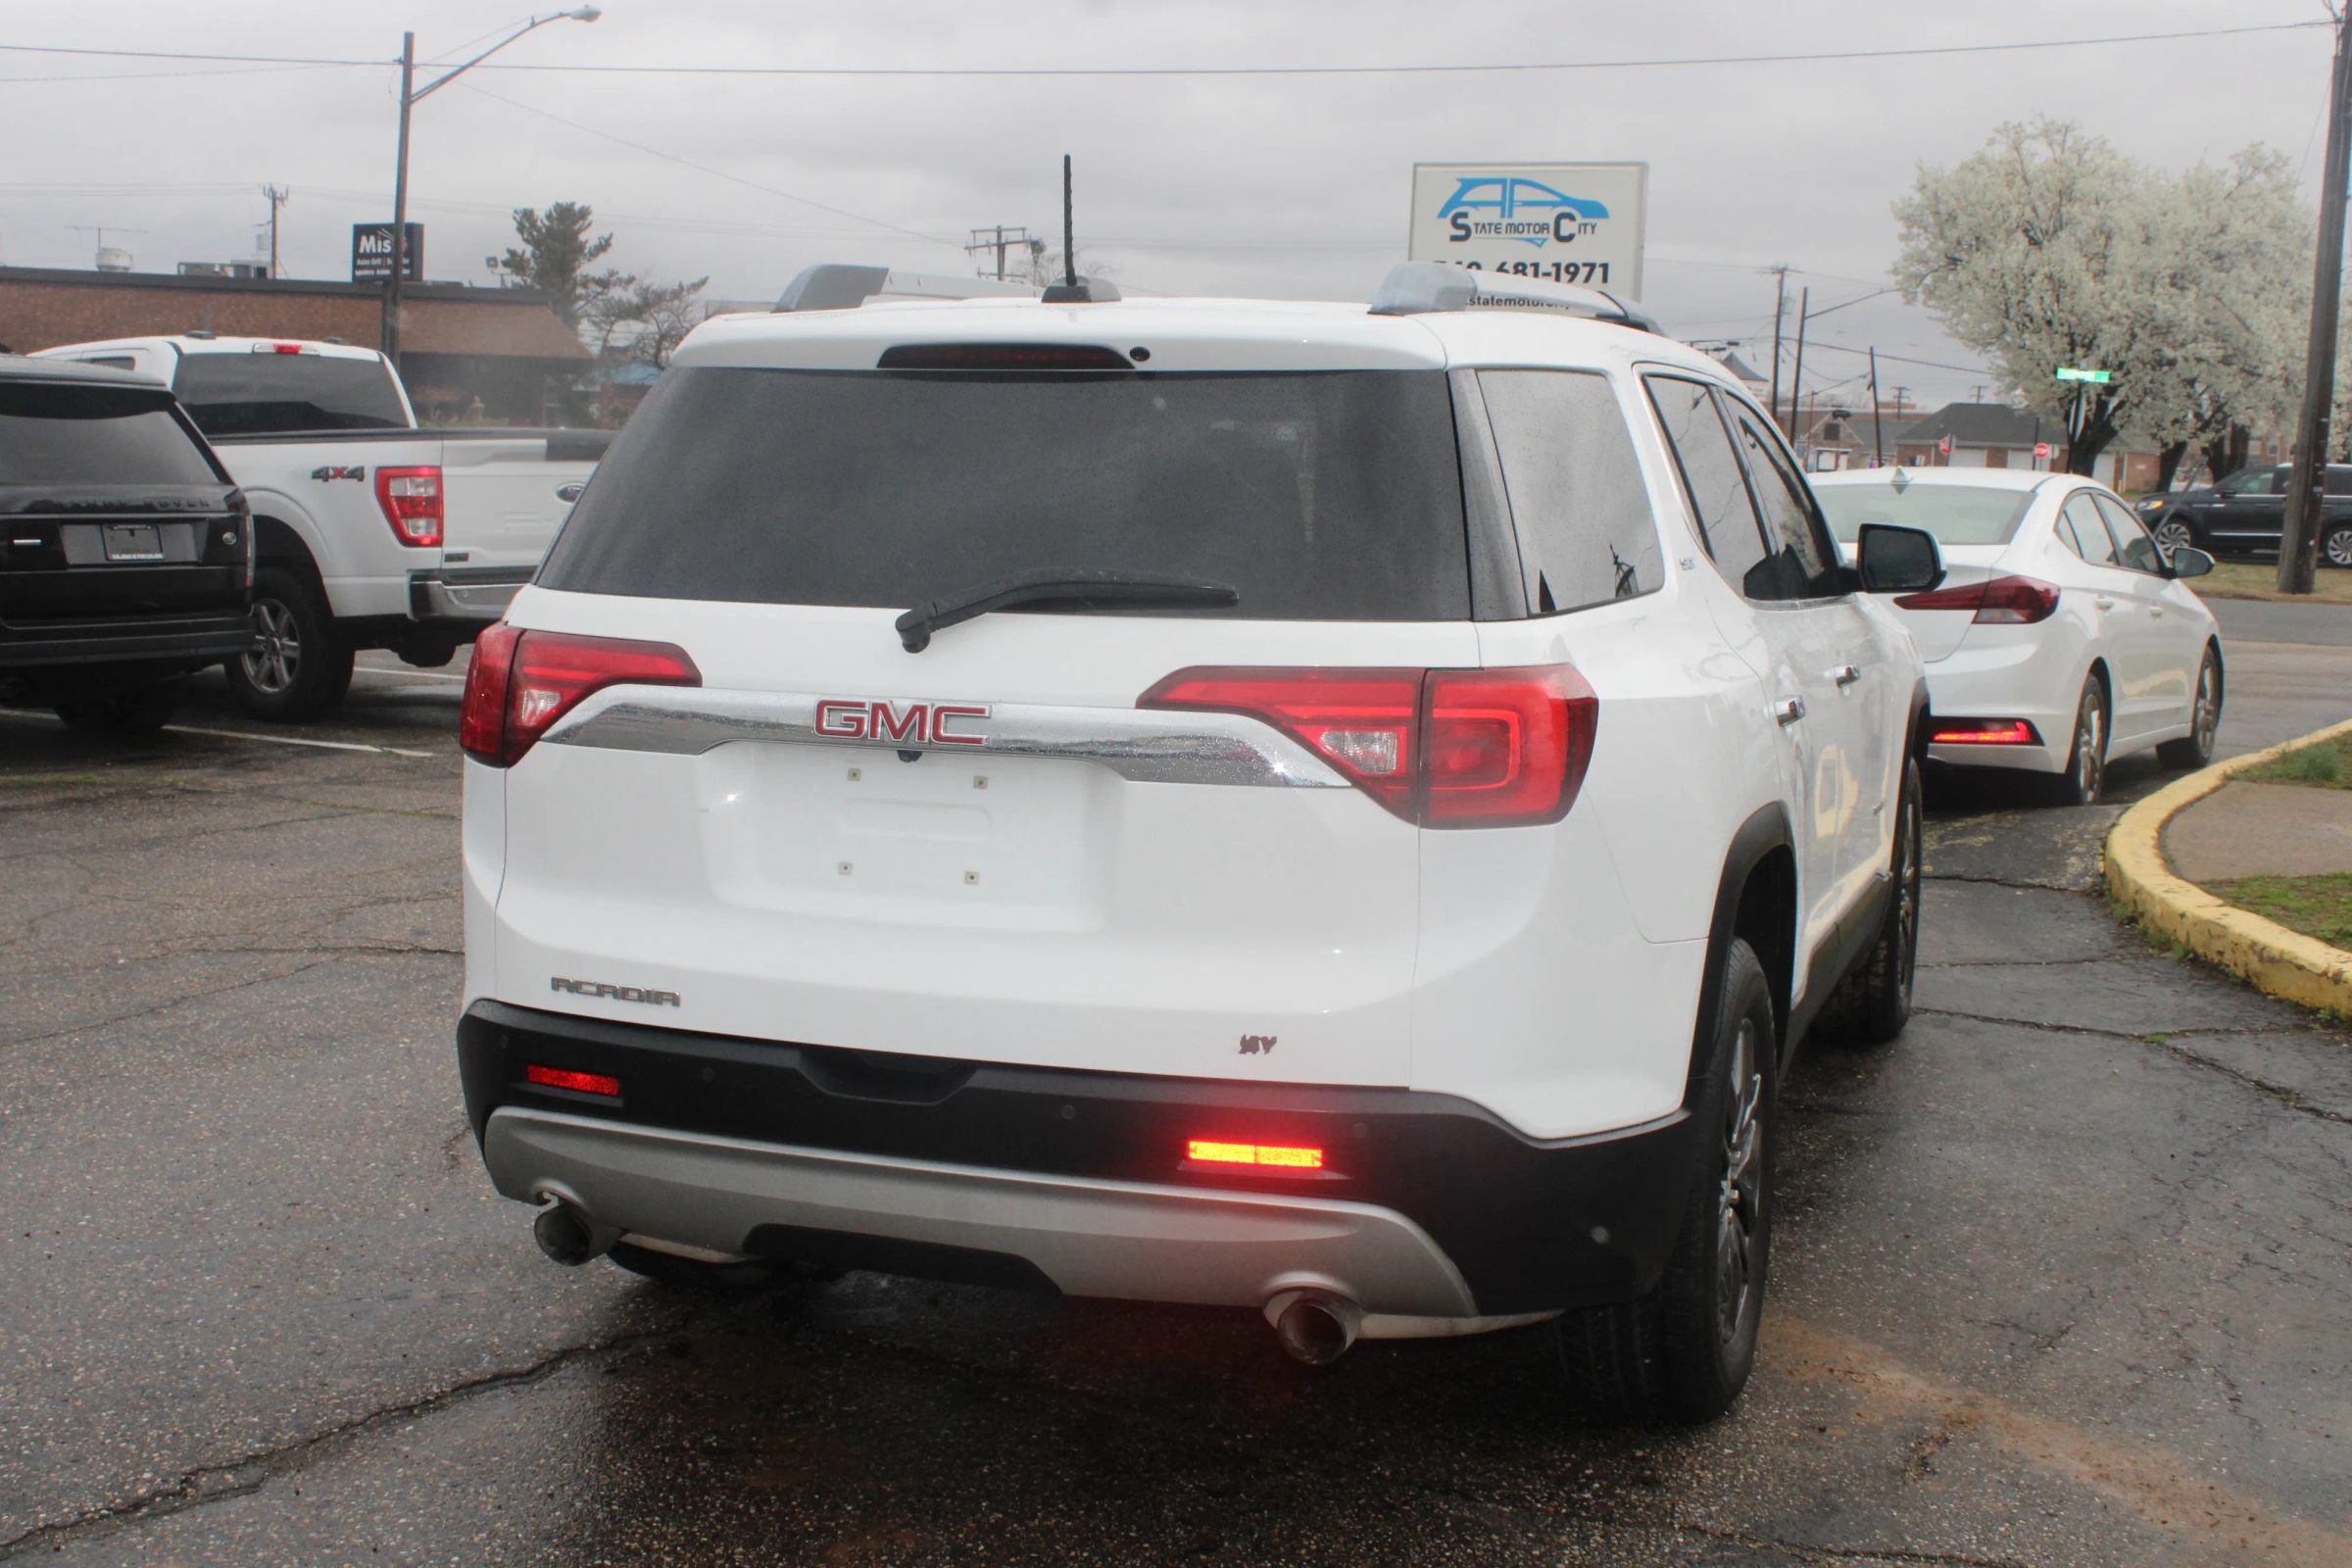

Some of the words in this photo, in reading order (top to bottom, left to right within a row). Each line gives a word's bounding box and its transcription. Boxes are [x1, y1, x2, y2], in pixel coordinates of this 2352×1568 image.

[1449, 212, 1501, 242] STATE
[1504, 221, 1549, 234] MOTOR
[1553, 212, 1597, 243] CITY
[359, 234, 394, 254] Mis
[814, 699, 990, 746] GMC
[551, 976, 681, 1007] ACADIA
